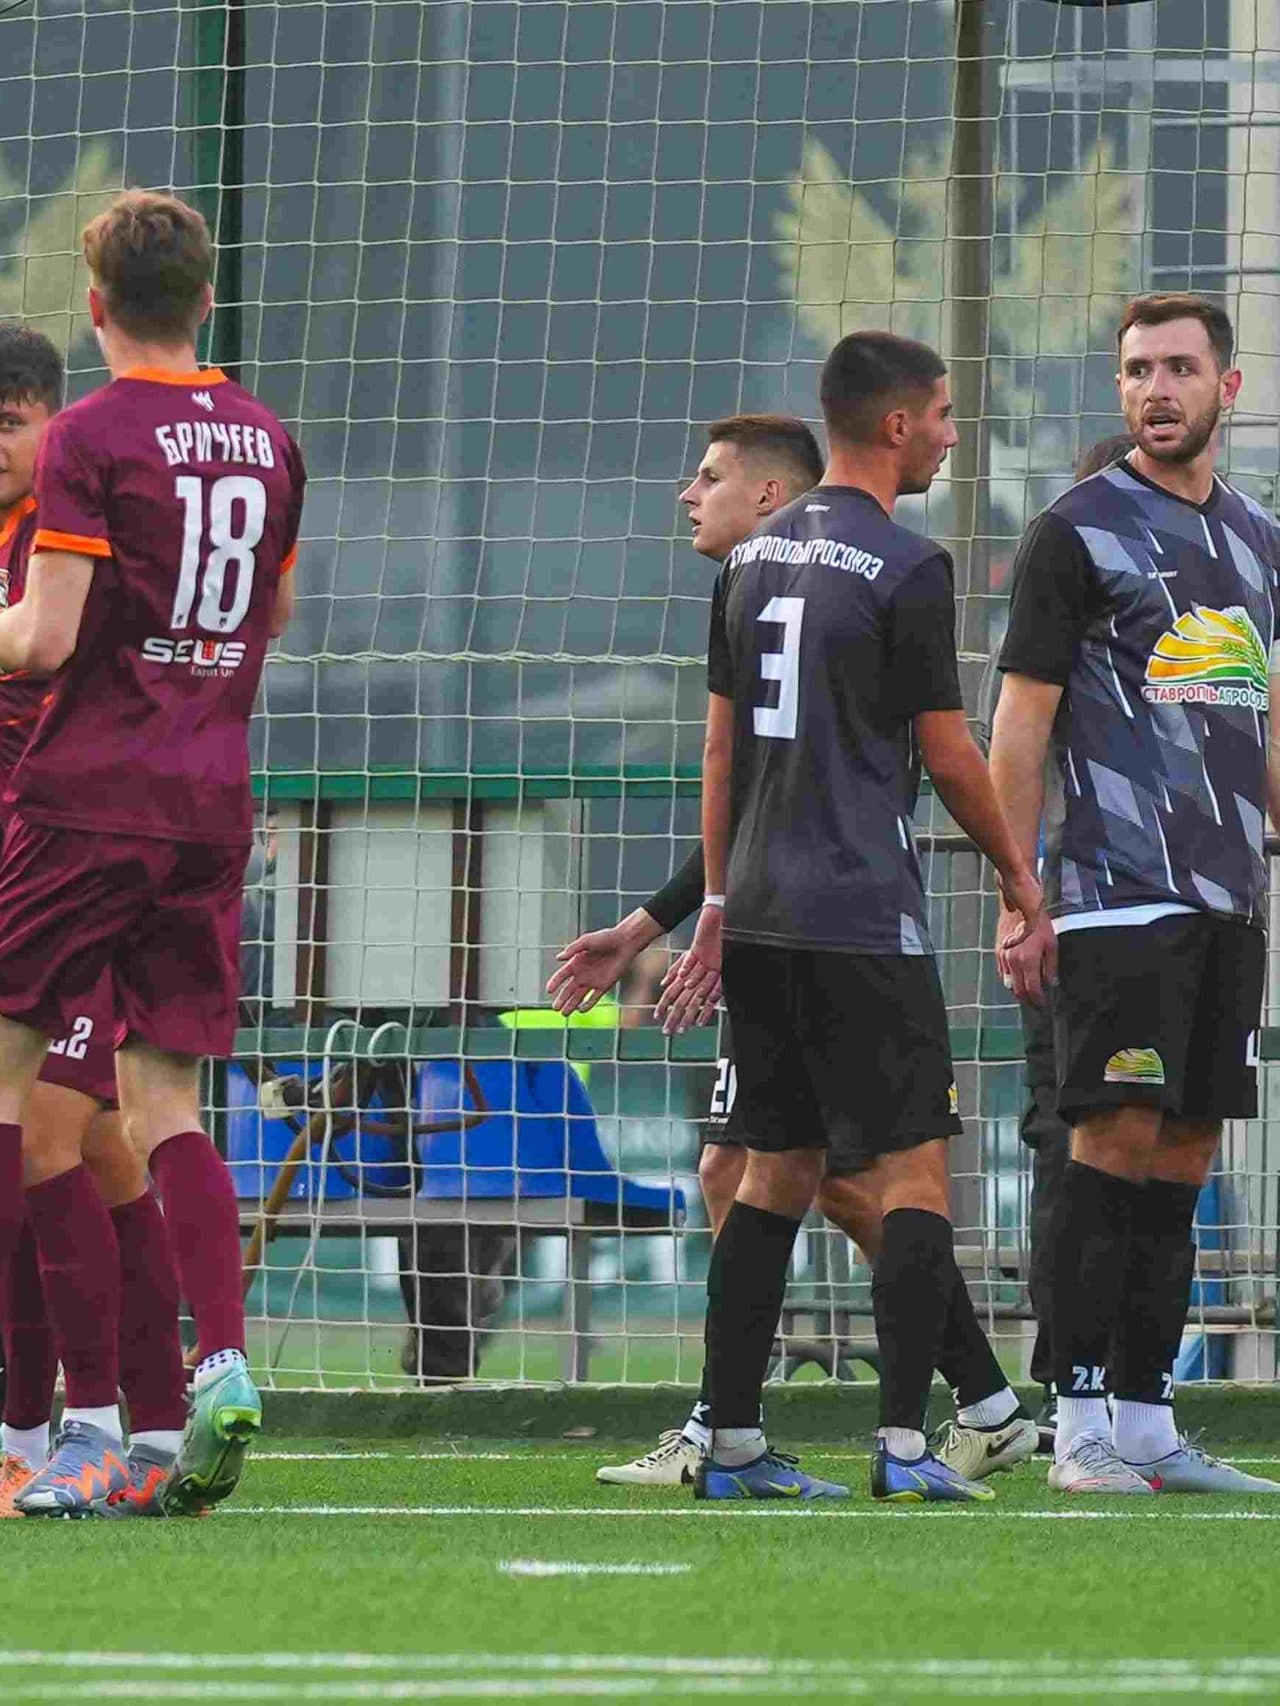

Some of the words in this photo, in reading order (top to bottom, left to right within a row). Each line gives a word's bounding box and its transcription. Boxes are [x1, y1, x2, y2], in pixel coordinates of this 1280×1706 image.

[155, 421, 275, 469] БРИЧЕЕВ
[171, 475, 267, 633] 18
[142, 637, 247, 668] SEUS
[753, 596, 805, 739] 3
